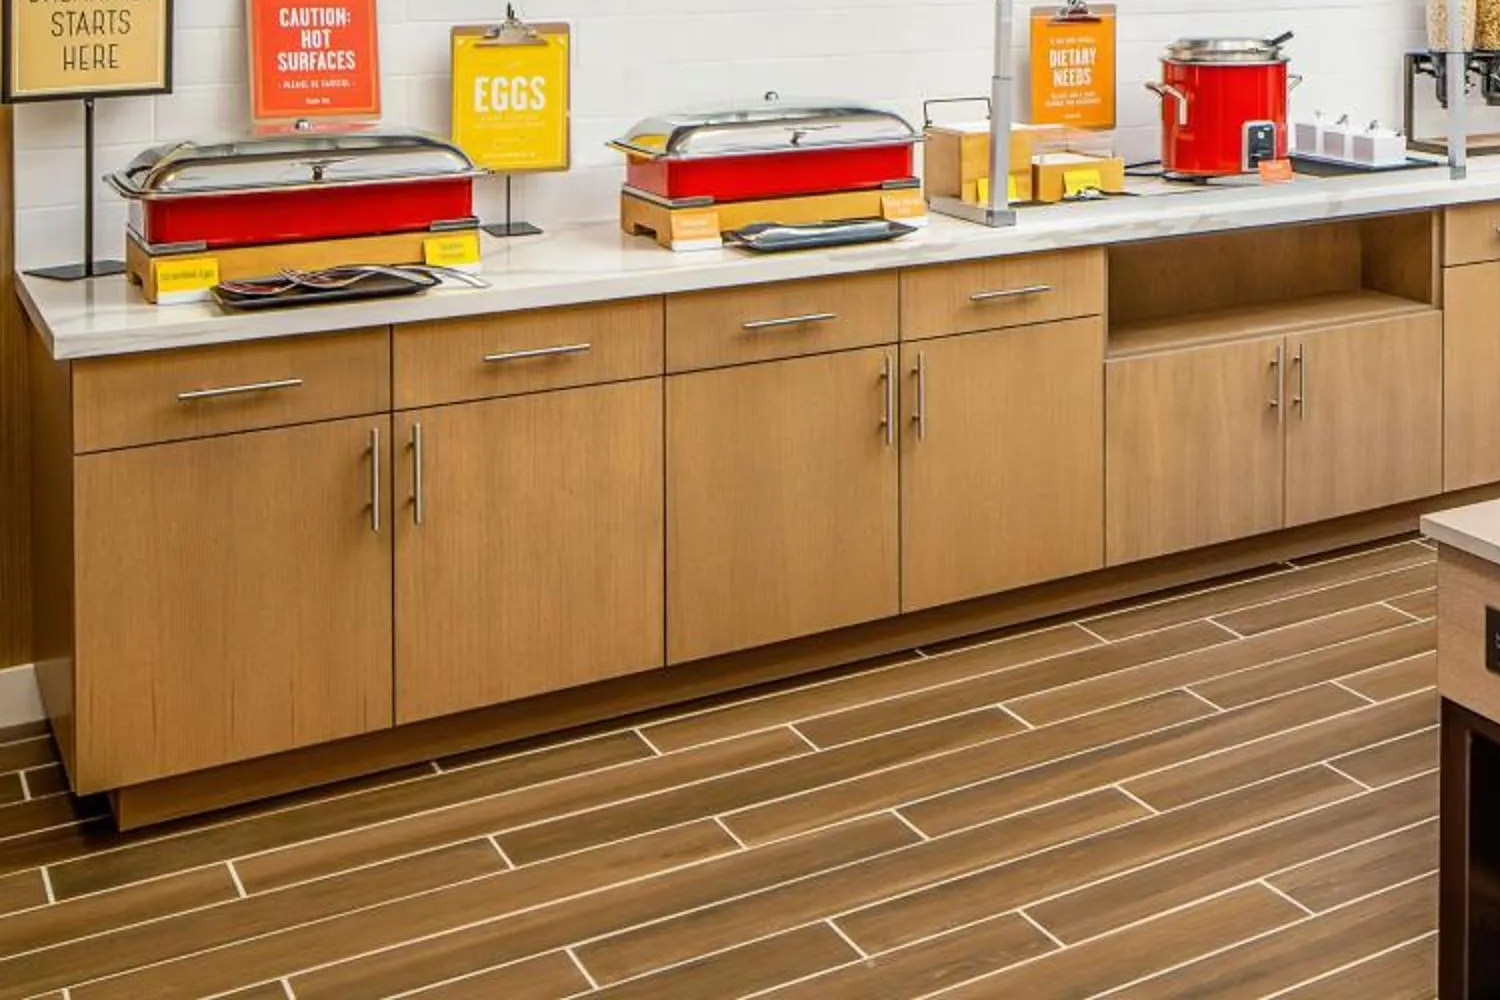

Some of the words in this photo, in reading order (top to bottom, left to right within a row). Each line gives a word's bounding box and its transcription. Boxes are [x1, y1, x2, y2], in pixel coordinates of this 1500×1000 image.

[51, 9, 131, 37] STARTS
[279, 7, 351, 28] CAUTION:
[301, 29, 332, 49] HOT
[63, 43, 119, 71] HERE
[277, 50, 356, 72] SURFACES
[1049, 47, 1097, 68] DIETARY
[1053, 67, 1093, 88] NEEDS
[474, 75, 546, 113] EGGS
